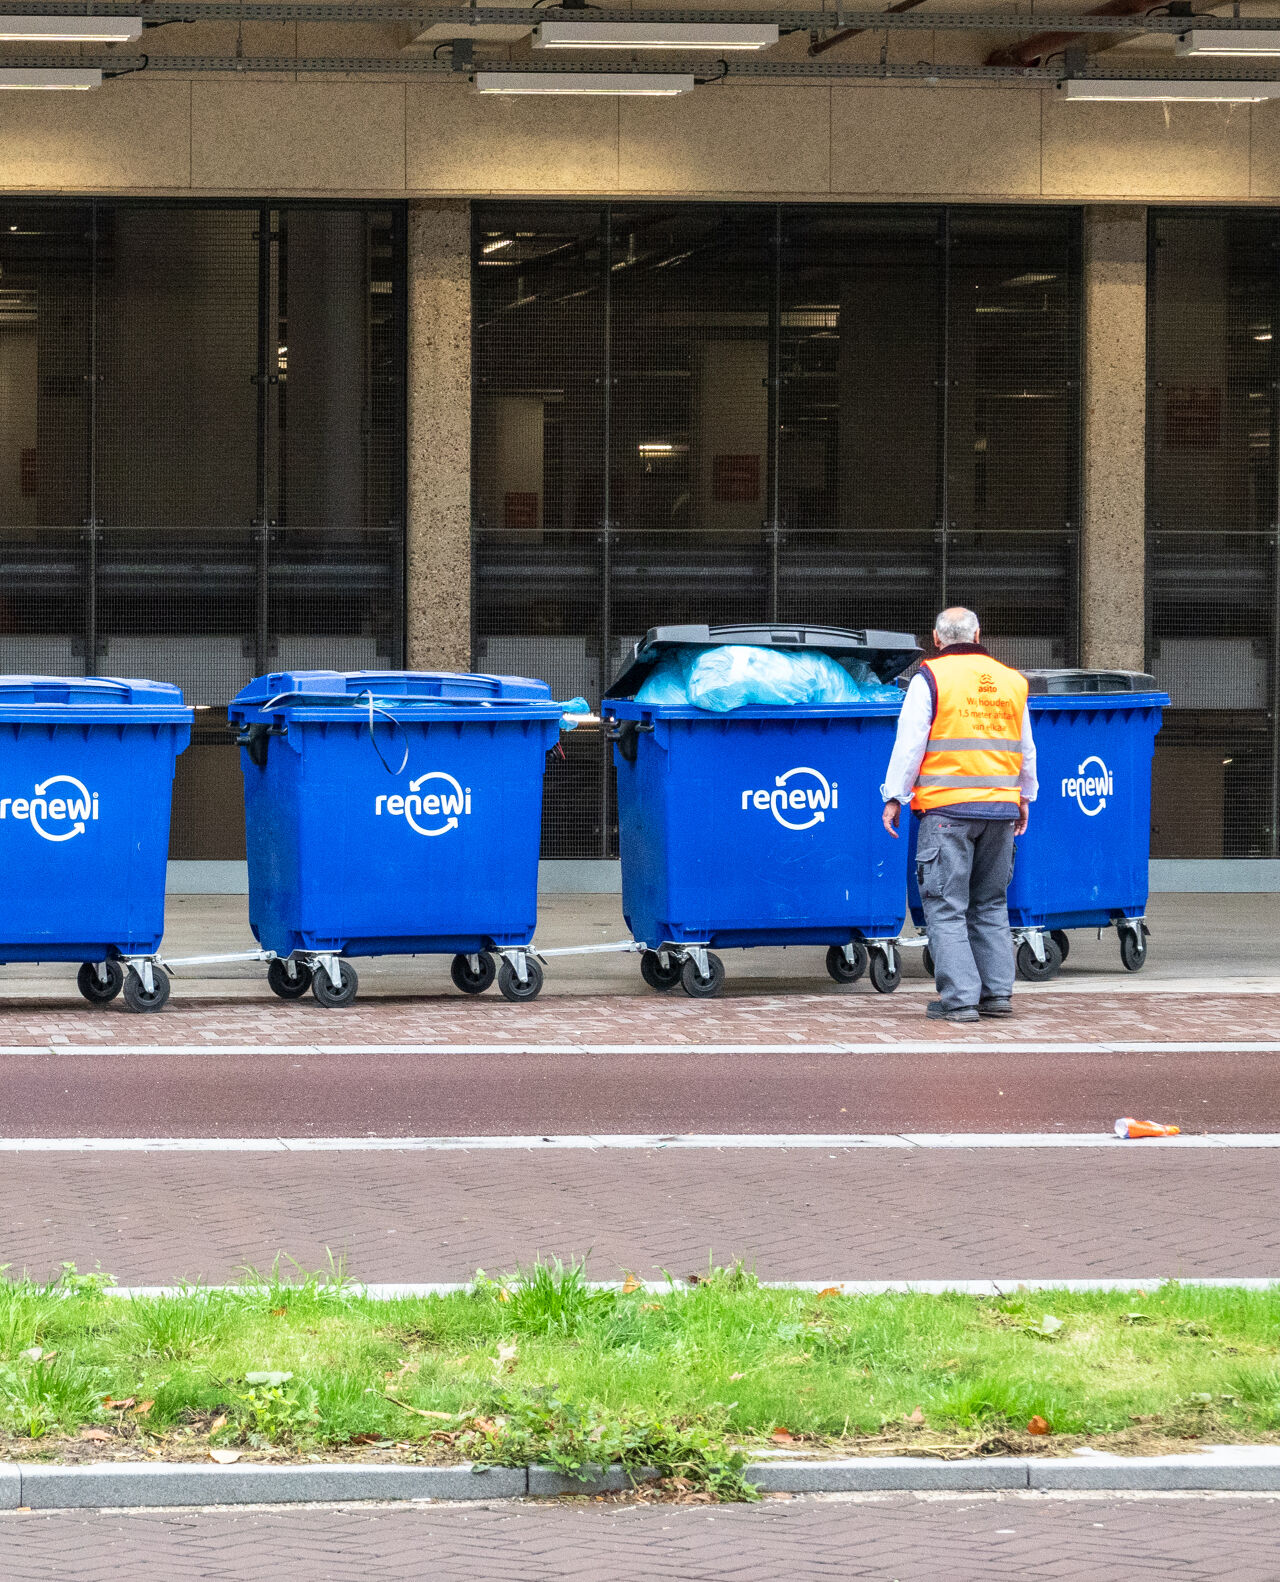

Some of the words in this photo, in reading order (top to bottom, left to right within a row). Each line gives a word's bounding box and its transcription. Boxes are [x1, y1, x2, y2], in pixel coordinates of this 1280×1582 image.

[978, 685, 997, 693] asito
[978, 698, 1010, 707] houden
[958, 709, 970, 718] 1,5
[970, 711, 991, 719] meter
[375, 780, 471, 822] renewi
[742, 775, 838, 818] renewi
[1062, 764, 1113, 805] renewi
[0, 785, 99, 828] renewi
